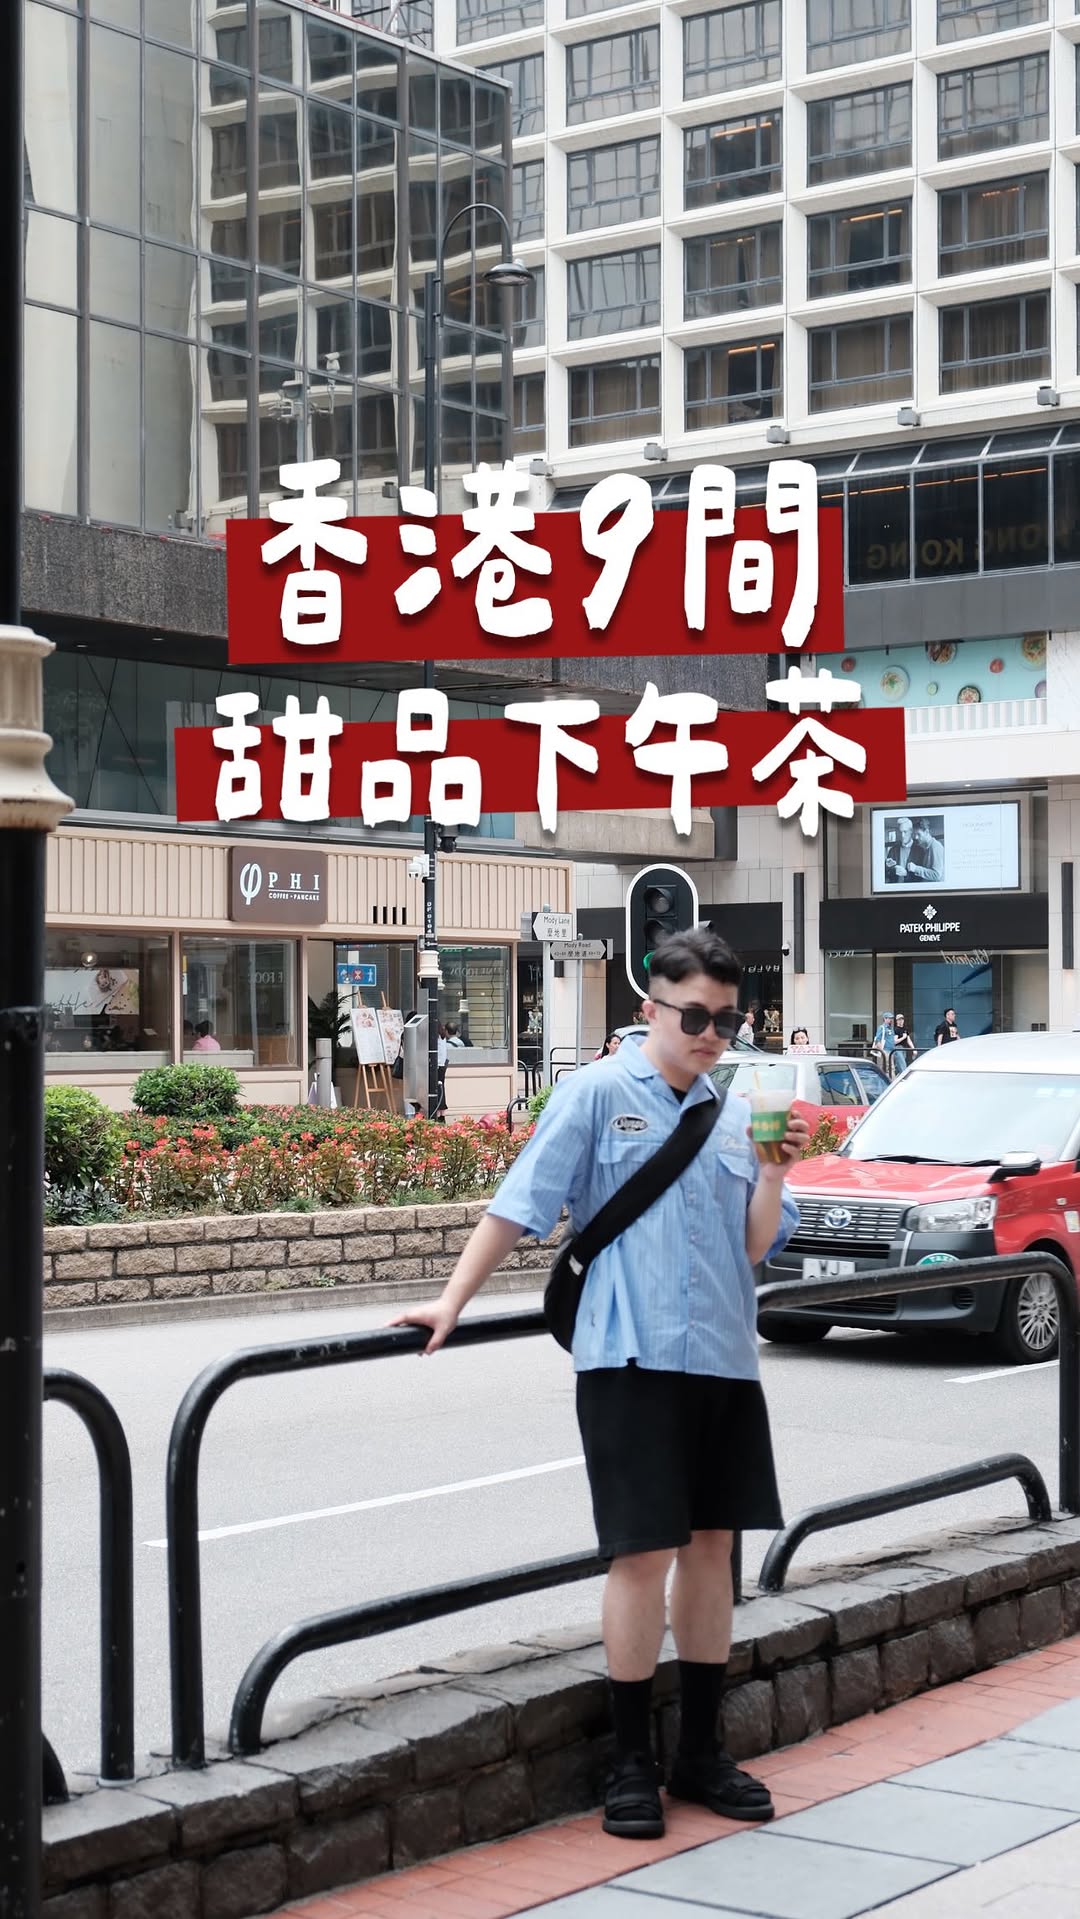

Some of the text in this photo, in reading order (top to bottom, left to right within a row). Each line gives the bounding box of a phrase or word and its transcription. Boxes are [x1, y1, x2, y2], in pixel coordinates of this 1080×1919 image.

[268, 872, 320, 890] PHI
[268, 892, 289, 900] COFFEE
[543, 916, 557, 925] Mody
[899, 922, 960, 933] PATEK PHILIPPE
[790, 1045, 820, 1054] TAXI
